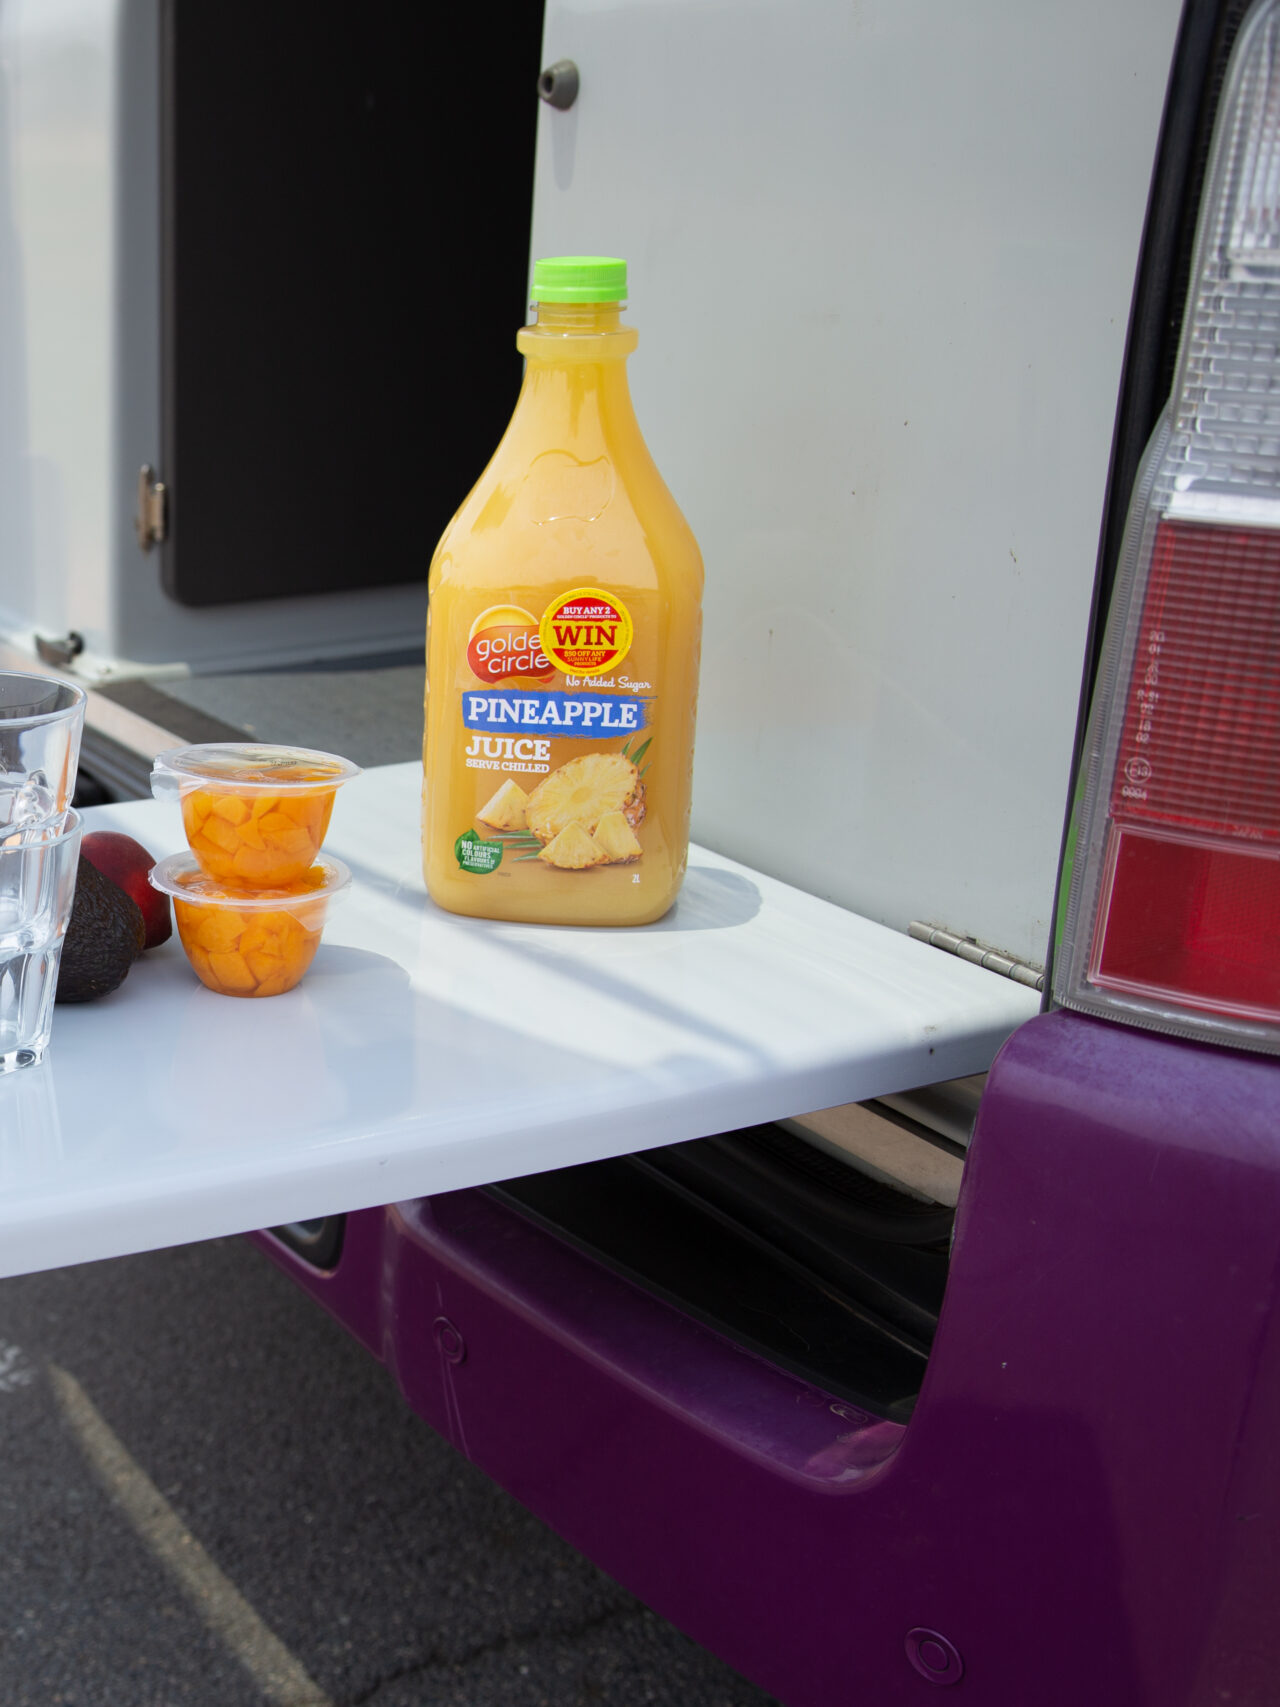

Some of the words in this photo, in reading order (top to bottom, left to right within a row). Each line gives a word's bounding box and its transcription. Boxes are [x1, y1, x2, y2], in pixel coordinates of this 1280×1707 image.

[563, 606, 583, 615] BUY
[583, 606, 605, 615] ANY
[605, 606, 611, 615] 2
[553, 625, 618, 646] WIN
[476, 632, 542, 662] golde
[487, 651, 550, 674] circle
[566, 674, 580, 687] No
[583, 675, 616, 687] Added
[618, 676, 652, 693] Sugar
[468, 696, 638, 728] PINEAPPLE
[465, 736, 551, 761] JUICE
[465, 758, 500, 771] SERVE
[501, 760, 550, 774] CHILLED
[461, 840, 473, 849] NO
